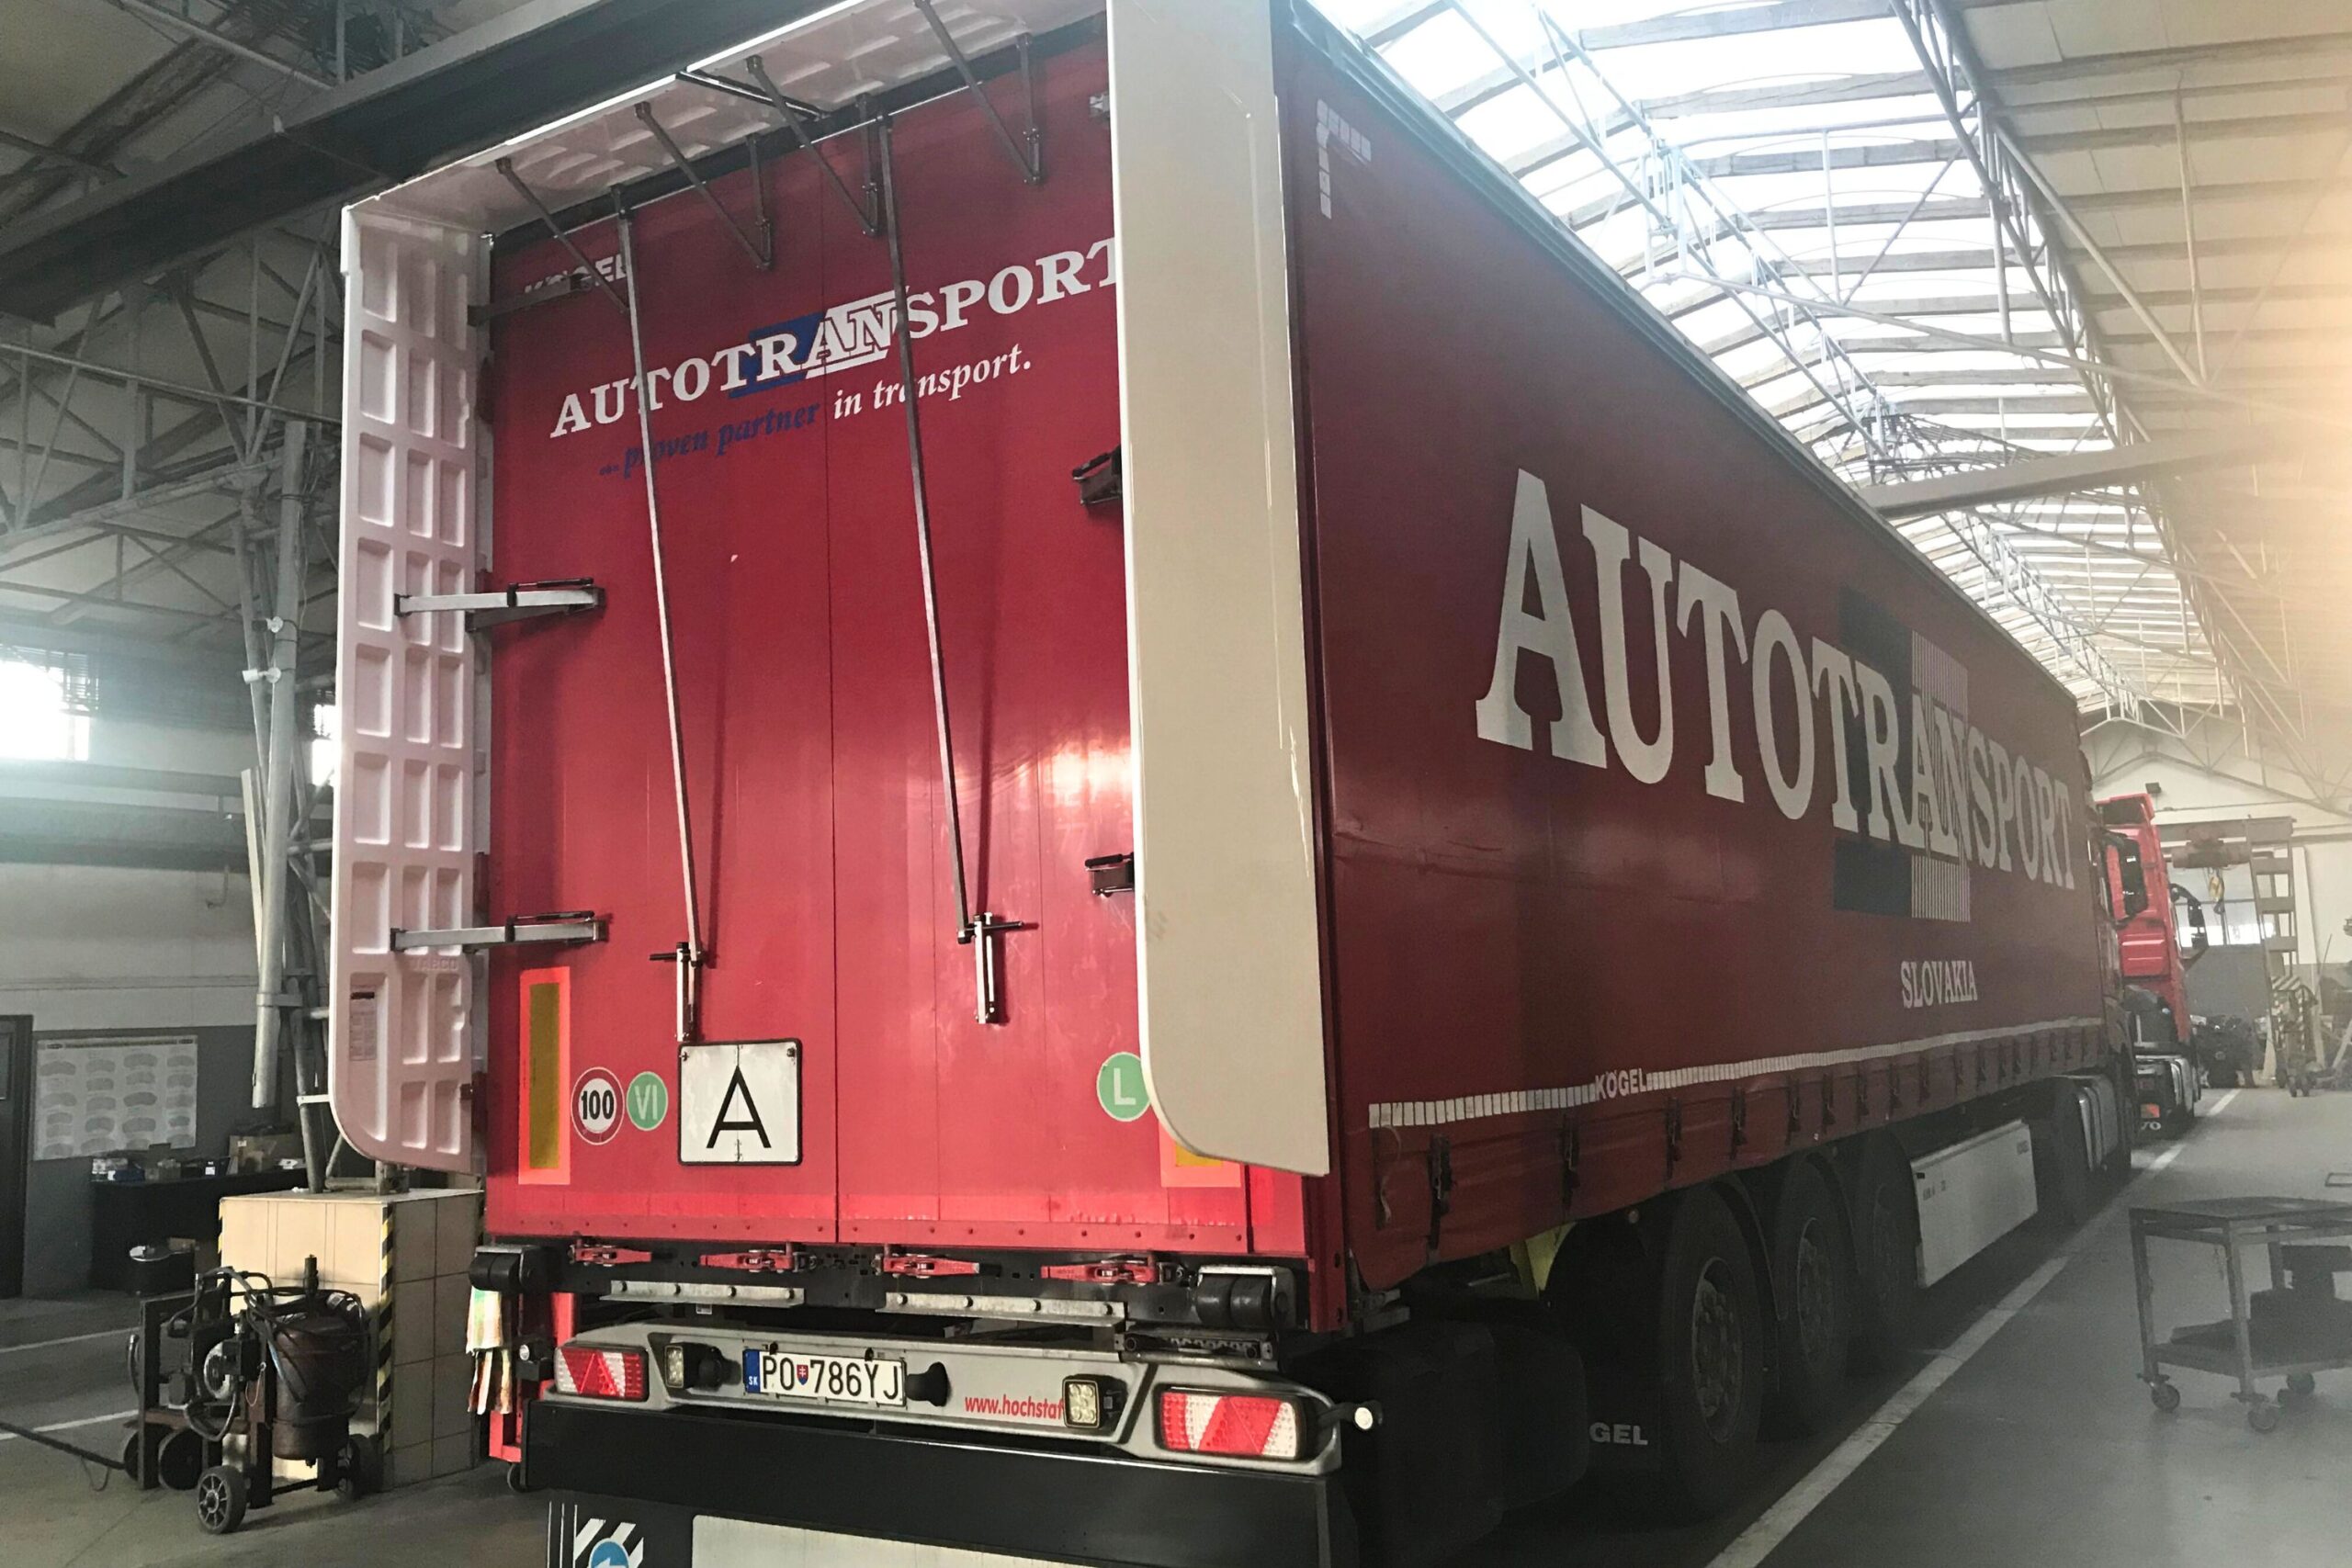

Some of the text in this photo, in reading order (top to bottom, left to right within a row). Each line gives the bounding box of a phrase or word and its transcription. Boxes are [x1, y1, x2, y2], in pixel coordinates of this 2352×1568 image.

[550, 236, 1116, 438] AUTOTRANSPORT
[717, 401, 821, 457] partner
[833, 389, 862, 419] in
[1476, 468, 2075, 891] AUTOTRANSPORT
[1900, 960, 1978, 1009] SLOVAKIA
[581, 1089, 615, 1121] 100
[634, 1084, 659, 1121] VI
[706, 1064, 781, 1149] A
[1113, 1067, 1136, 1106] L
[1595, 1067, 1647, 1100] KÖGEL
[748, 1375, 759, 1386] SK
[762, 1355, 899, 1401] PO 786YJ
